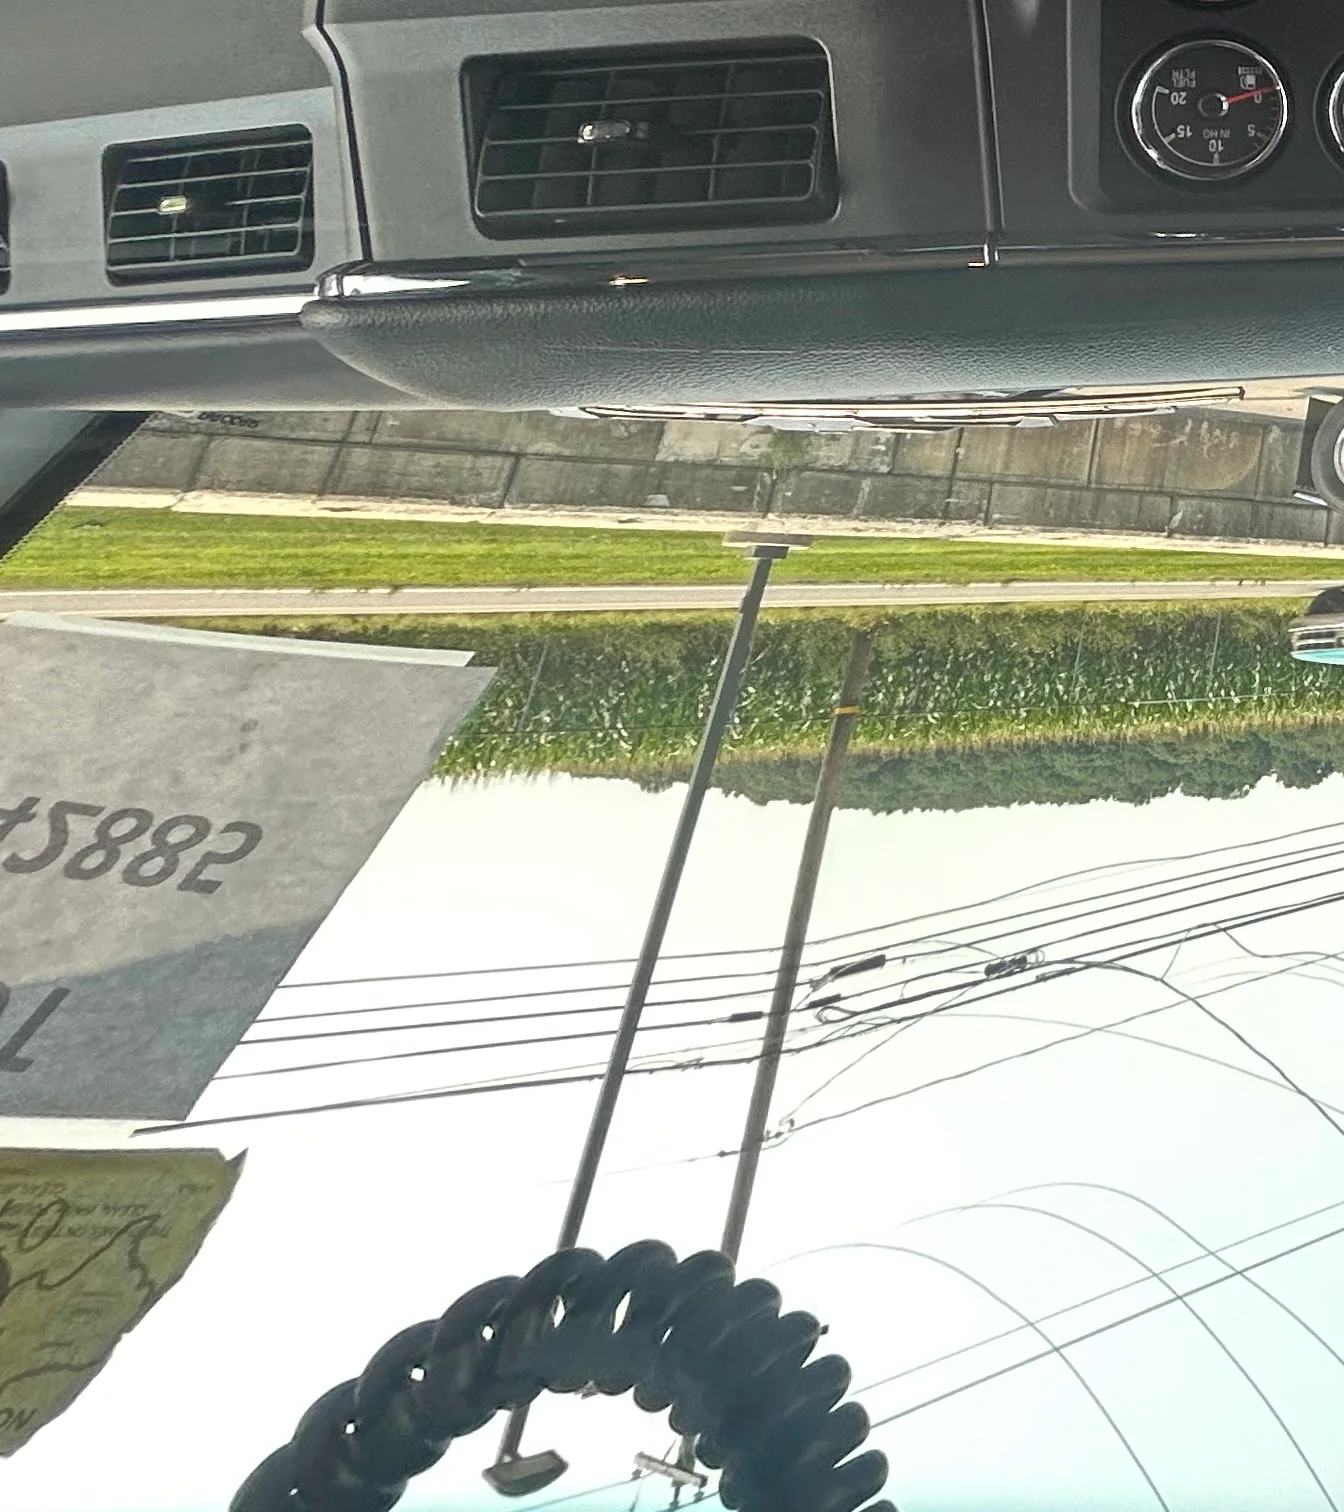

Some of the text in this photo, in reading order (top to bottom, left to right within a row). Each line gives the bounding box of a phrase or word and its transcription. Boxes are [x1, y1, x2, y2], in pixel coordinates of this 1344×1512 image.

[1172, 79, 1196, 87] FUEL
[1170, 92, 1187, 104] 20
[1176, 125, 1193, 138] 15
[1202, 129, 1230, 139] IN HG
[1247, 124, 1256, 137] 5
[1208, 140, 1224, 152] 10
